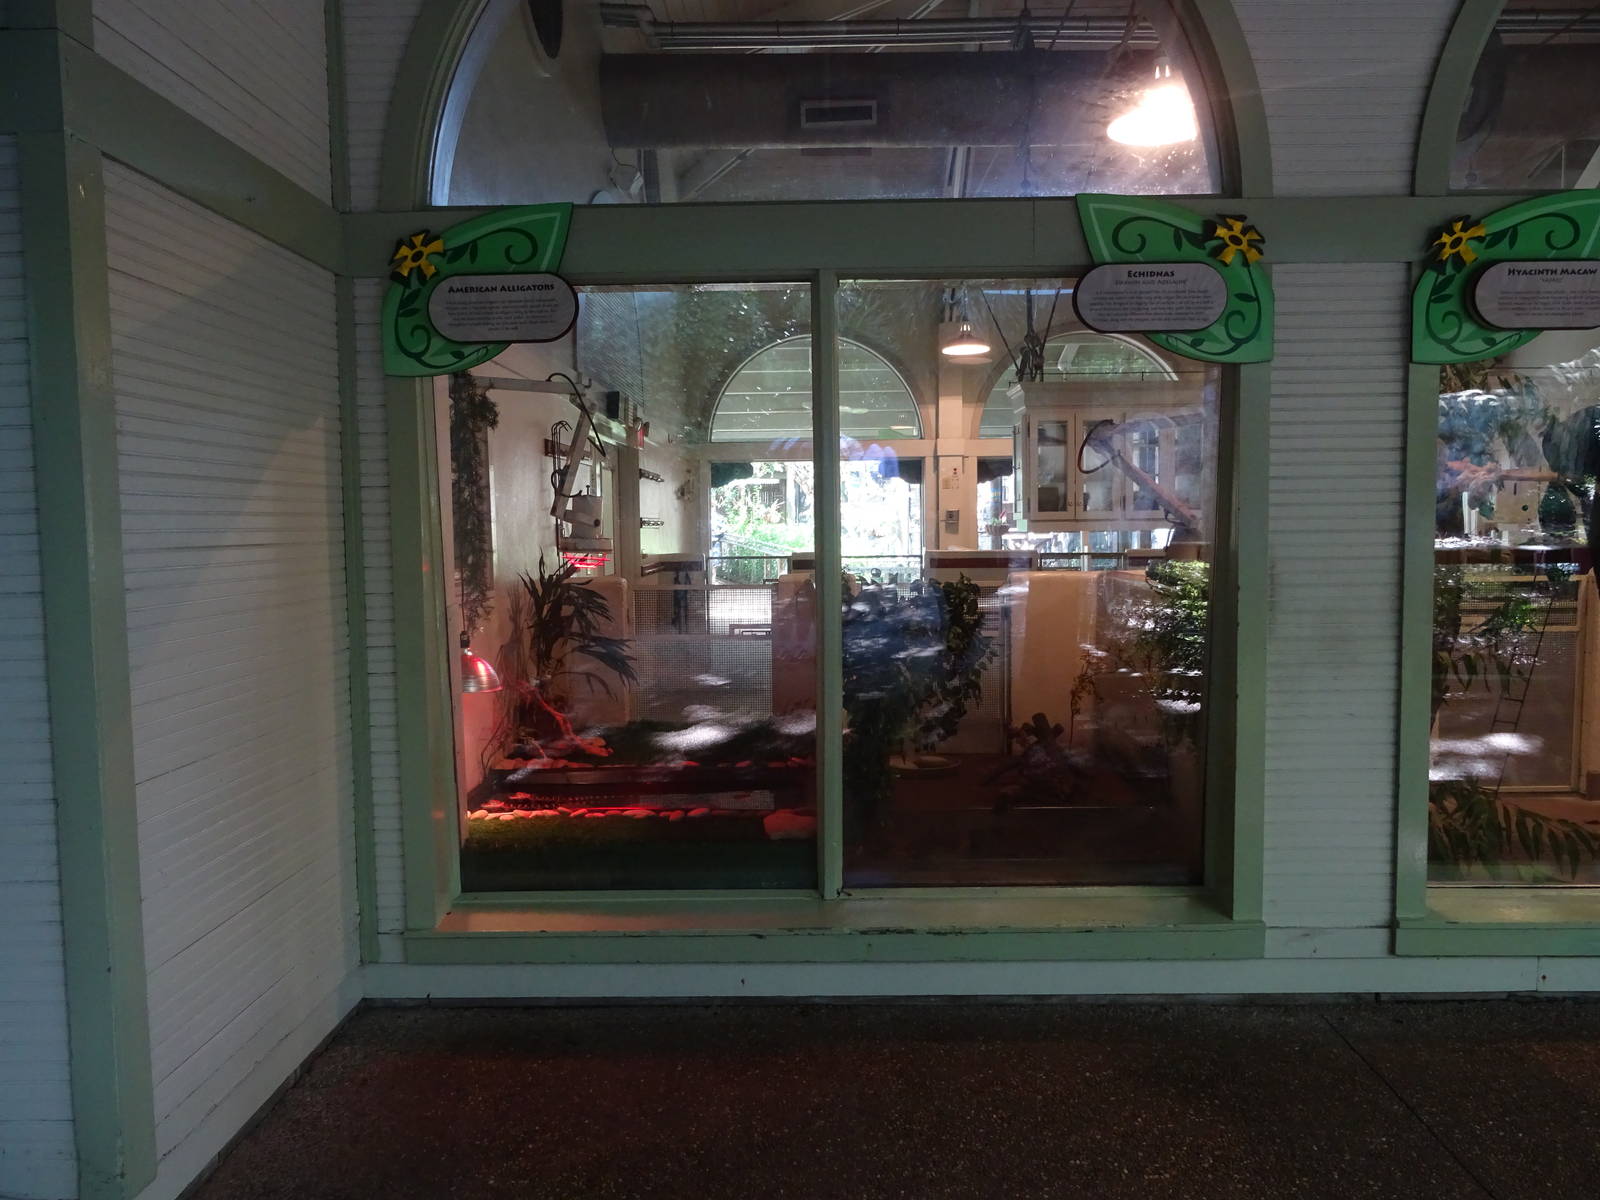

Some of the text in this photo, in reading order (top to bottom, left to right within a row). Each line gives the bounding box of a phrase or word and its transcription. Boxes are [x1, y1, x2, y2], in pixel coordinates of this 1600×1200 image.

[1127, 270, 1175, 278] ECHIDNAS
[1507, 268, 1557, 276] HYACINTH
[448, 284, 554, 294] AMERICAN ALLIGATORS
